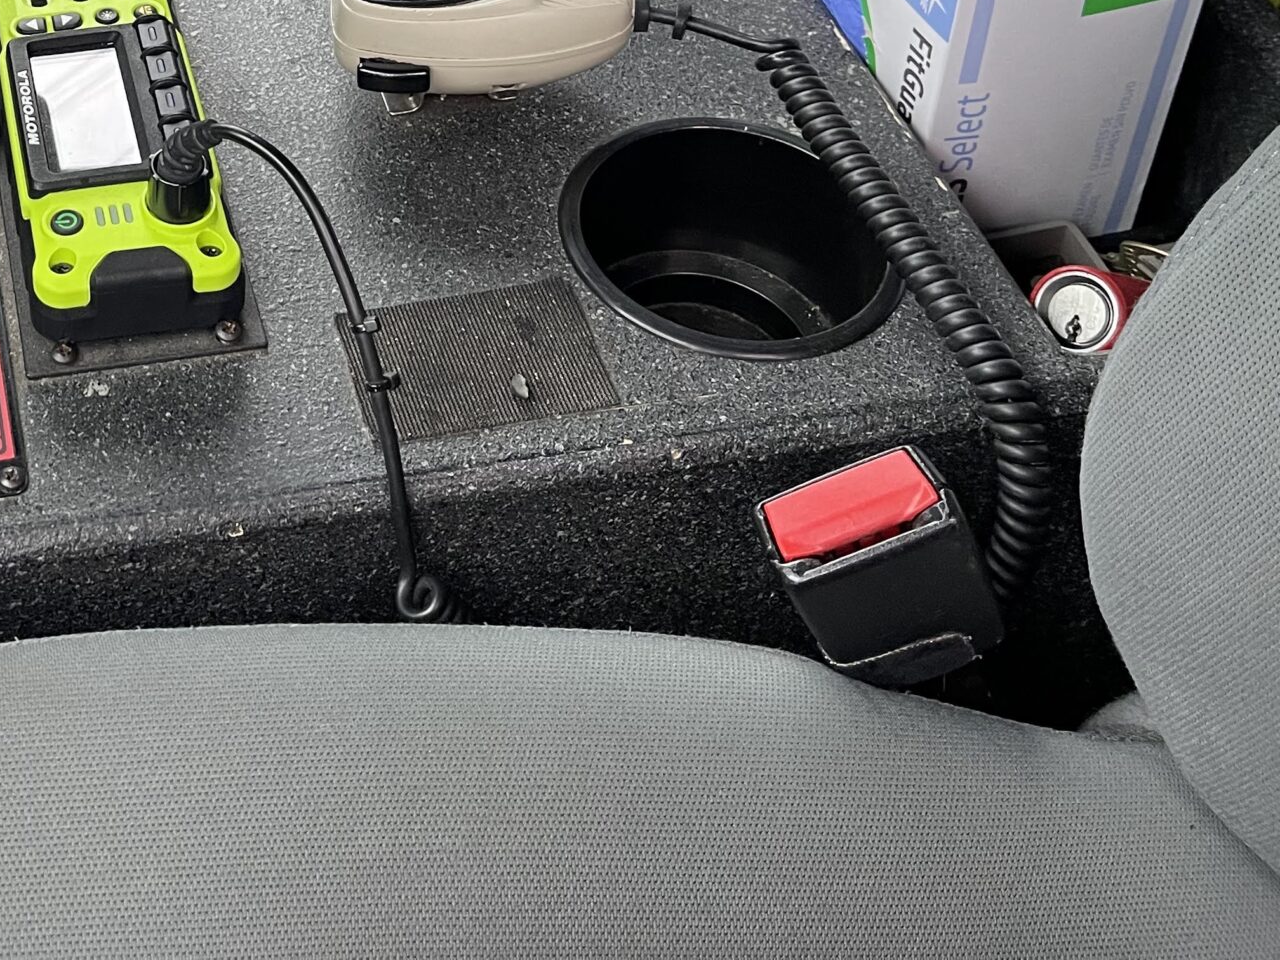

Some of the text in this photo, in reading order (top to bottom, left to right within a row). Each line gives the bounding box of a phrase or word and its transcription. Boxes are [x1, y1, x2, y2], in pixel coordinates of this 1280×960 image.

[17, 70, 40, 146] MOTOROLA
[897, 27, 933, 125] FitGua
[939, 92, 991, 174] Select
